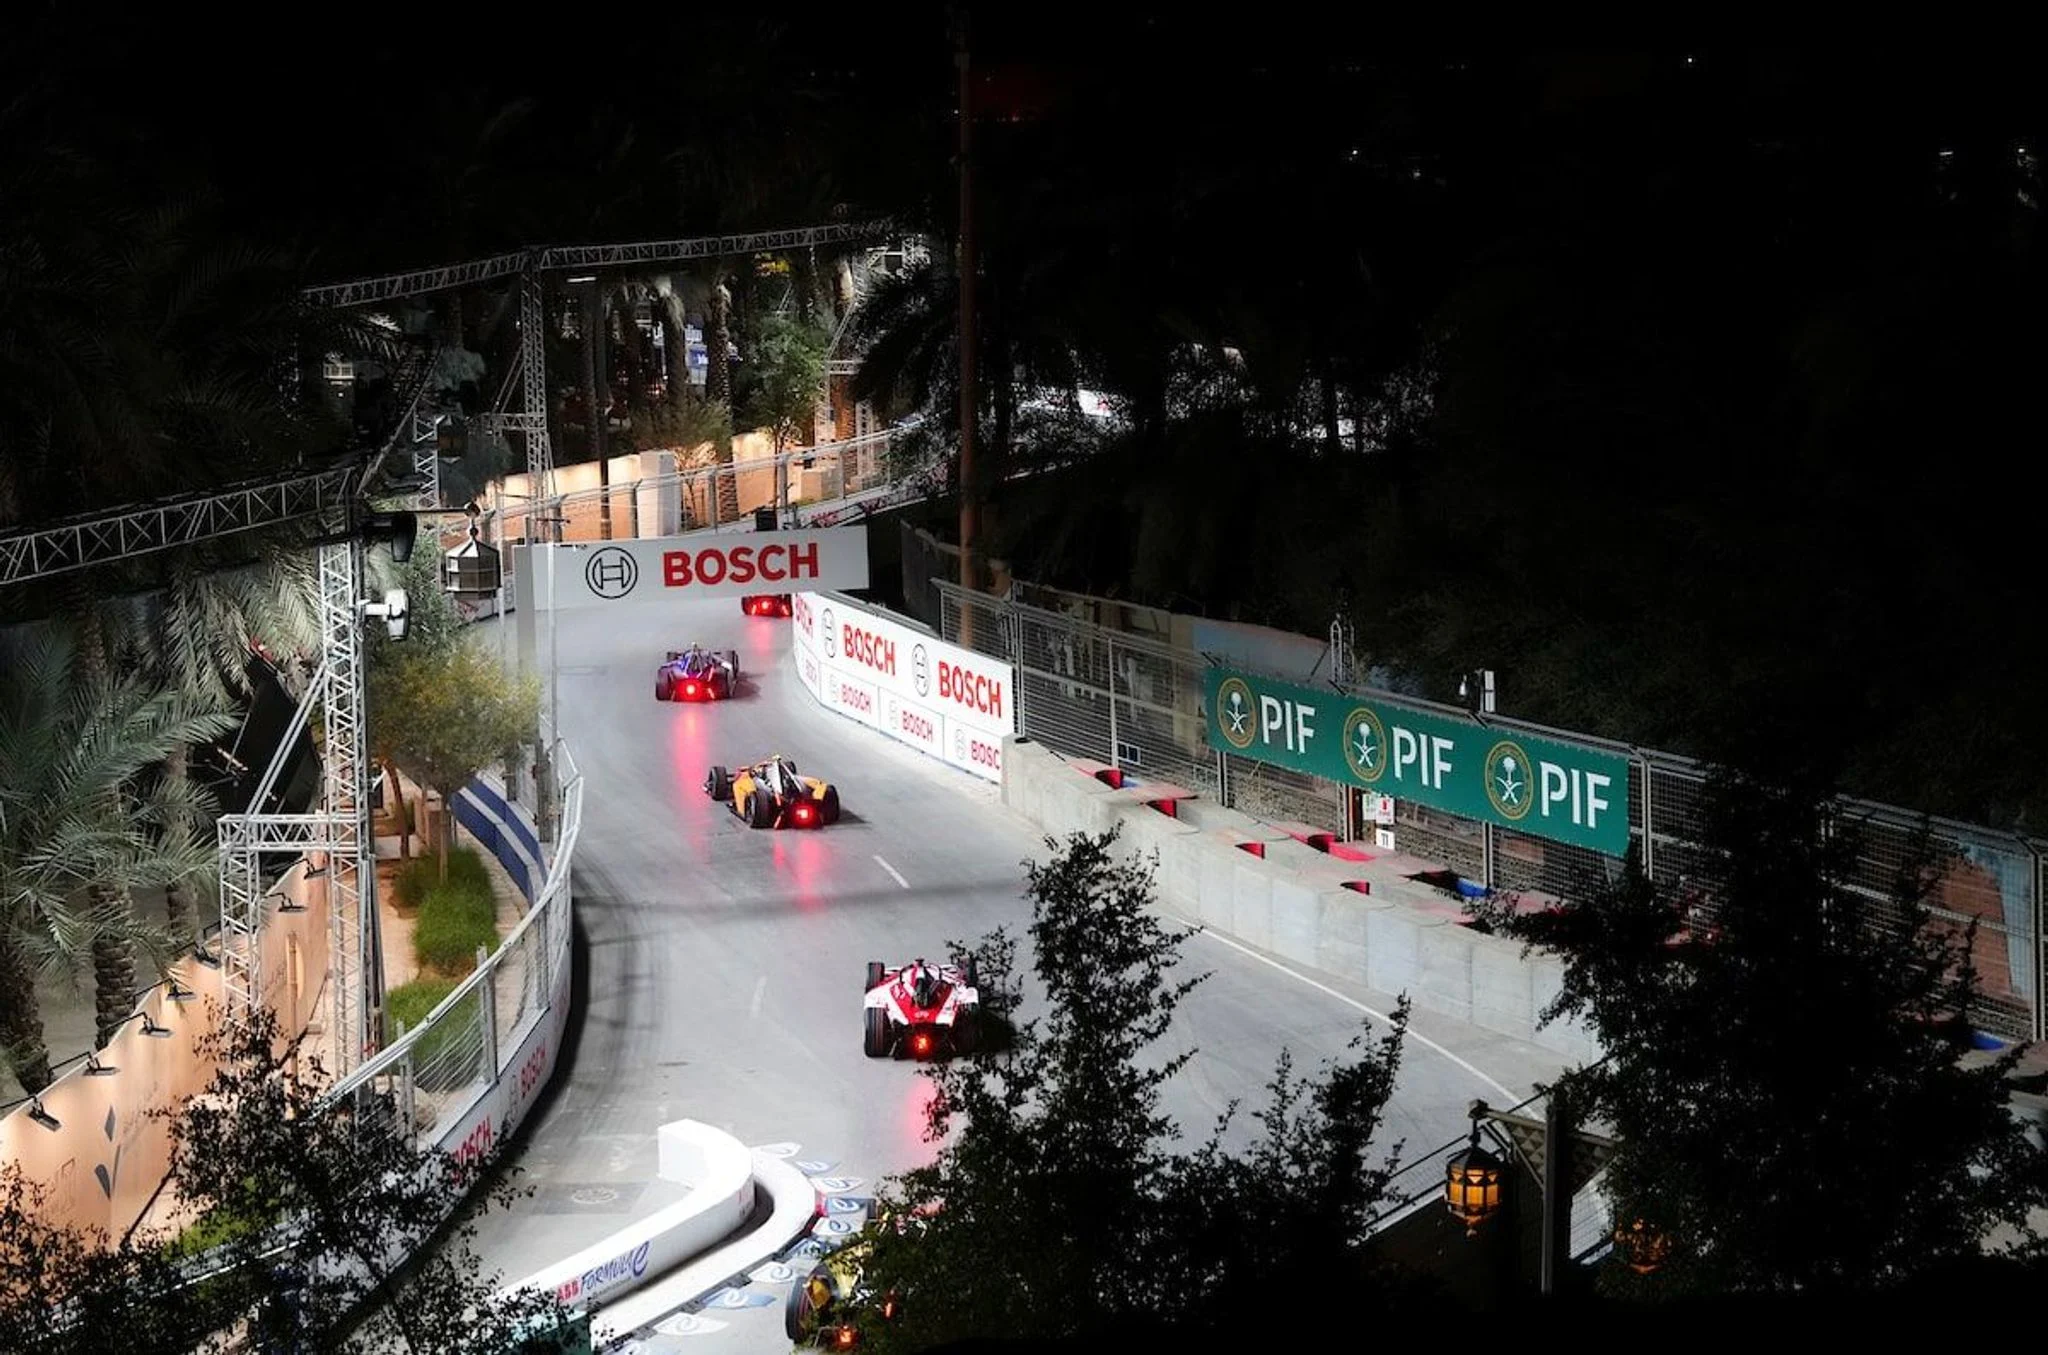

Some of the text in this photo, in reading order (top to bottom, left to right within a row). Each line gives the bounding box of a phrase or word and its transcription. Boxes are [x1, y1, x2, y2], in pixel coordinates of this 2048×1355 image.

[663, 542, 819, 588] BOSCH
[843, 624, 896, 677] BOSCH
[841, 683, 872, 715] BOSCH
[938, 660, 1002, 719] BOSCH
[902, 710, 933, 743] BOSCH
[1260, 694, 1316, 754] PIF
[1391, 726, 1454, 790] PIF
[1540, 761, 1611, 829] PIF
[452, 1115, 493, 1184] OSCH
[556, 1279, 580, 1303] ABB
